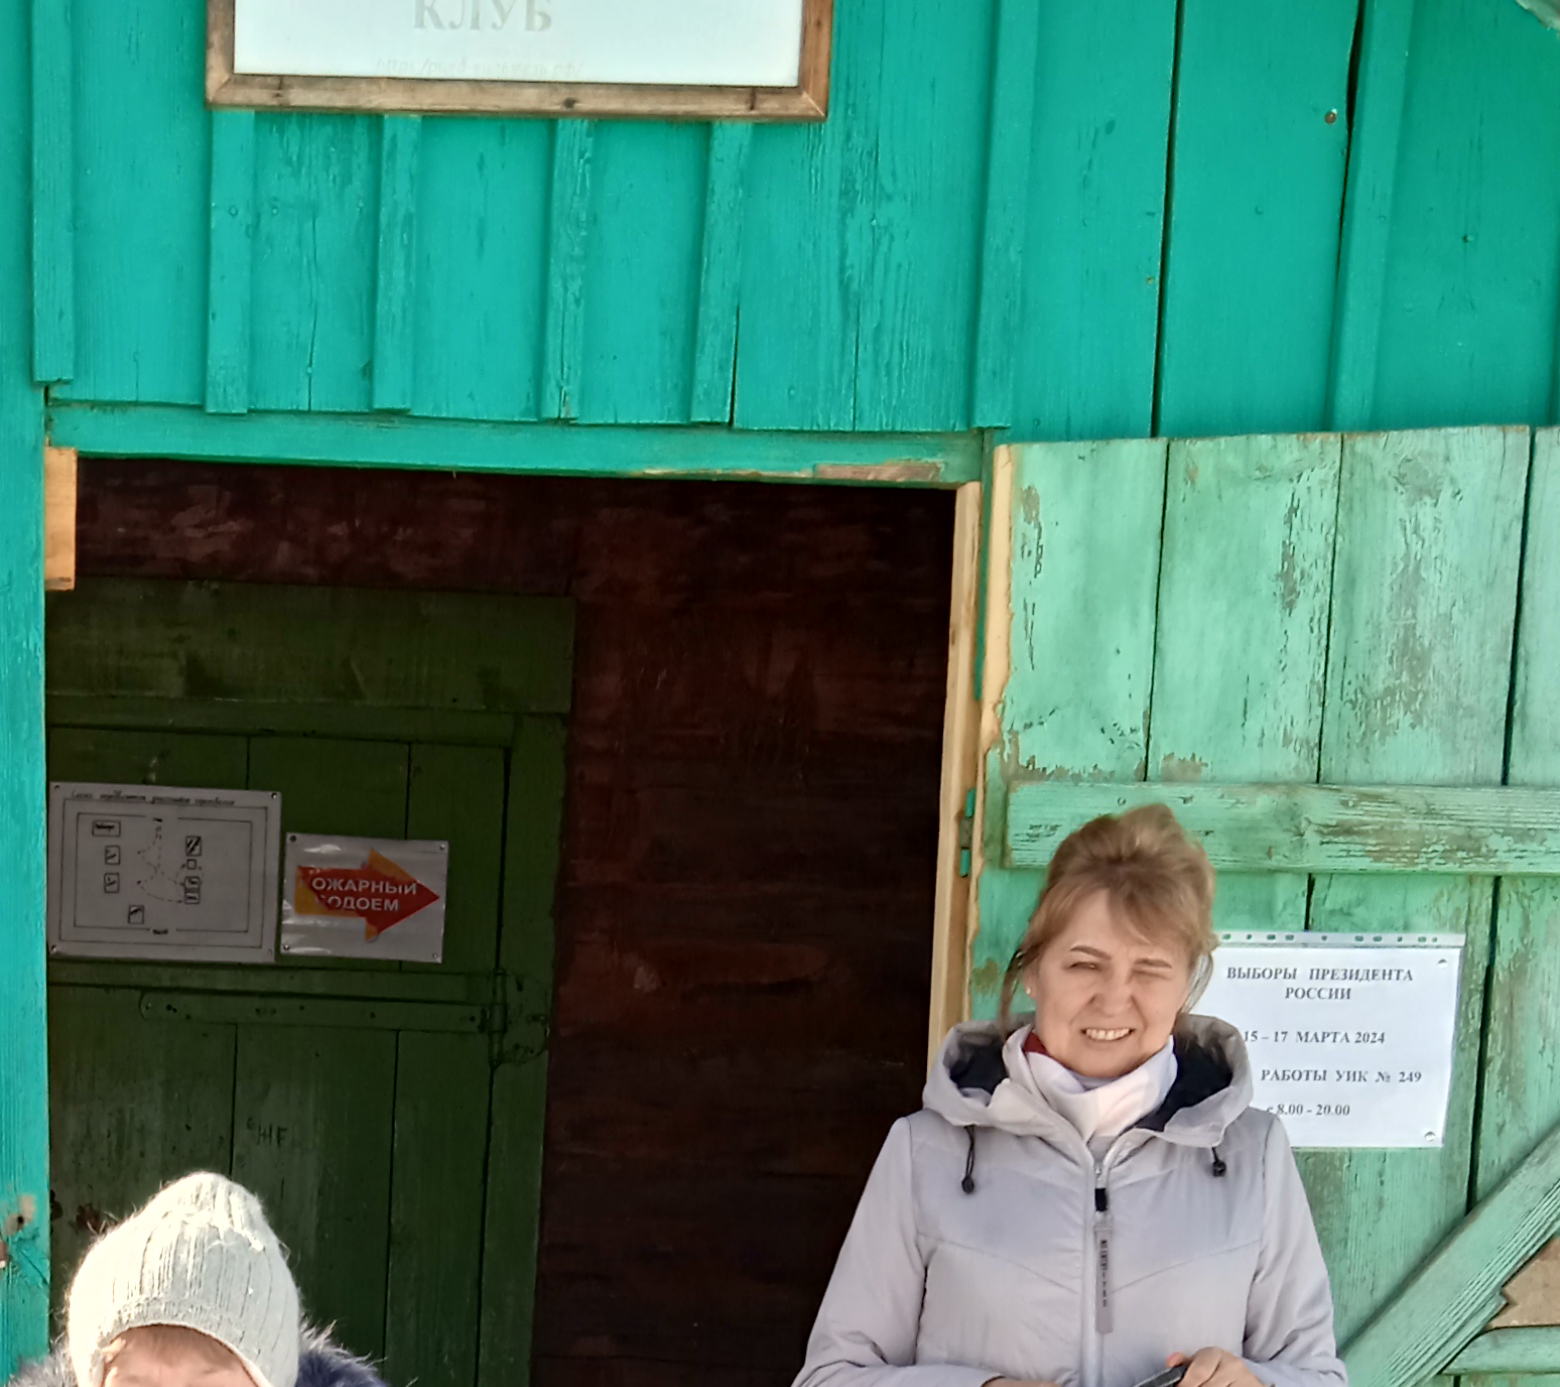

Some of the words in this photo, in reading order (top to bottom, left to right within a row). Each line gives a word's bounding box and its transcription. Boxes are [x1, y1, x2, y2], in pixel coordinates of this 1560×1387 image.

[413, 0, 553, 31] КЛУБ
[311, 877, 418, 896] ОЖАРНЫЙ
[320, 894, 400, 912] ОДОЕМ
[1226, 966, 1298, 980] ВЫБОРЫ
[1308, 967, 1414, 982] ПРЕЗИДЕНТА
[1284, 986, 1352, 1000] РОССИИ
[1273, 1030, 1288, 1043] 17
[1295, 1031, 1351, 1044] МАРТА
[1354, 1031, 1386, 1044] 2024
[1260, 1069, 1328, 1082] РАБОТЫ
[1335, 1069, 1369, 1083] УИК
[1374, 1070, 1391, 1083] №
[1398, 1070, 1422, 1083] 249
[1276, 1103, 1304, 1116] 8.00
[1315, 1103, 1351, 1116] 20.00
